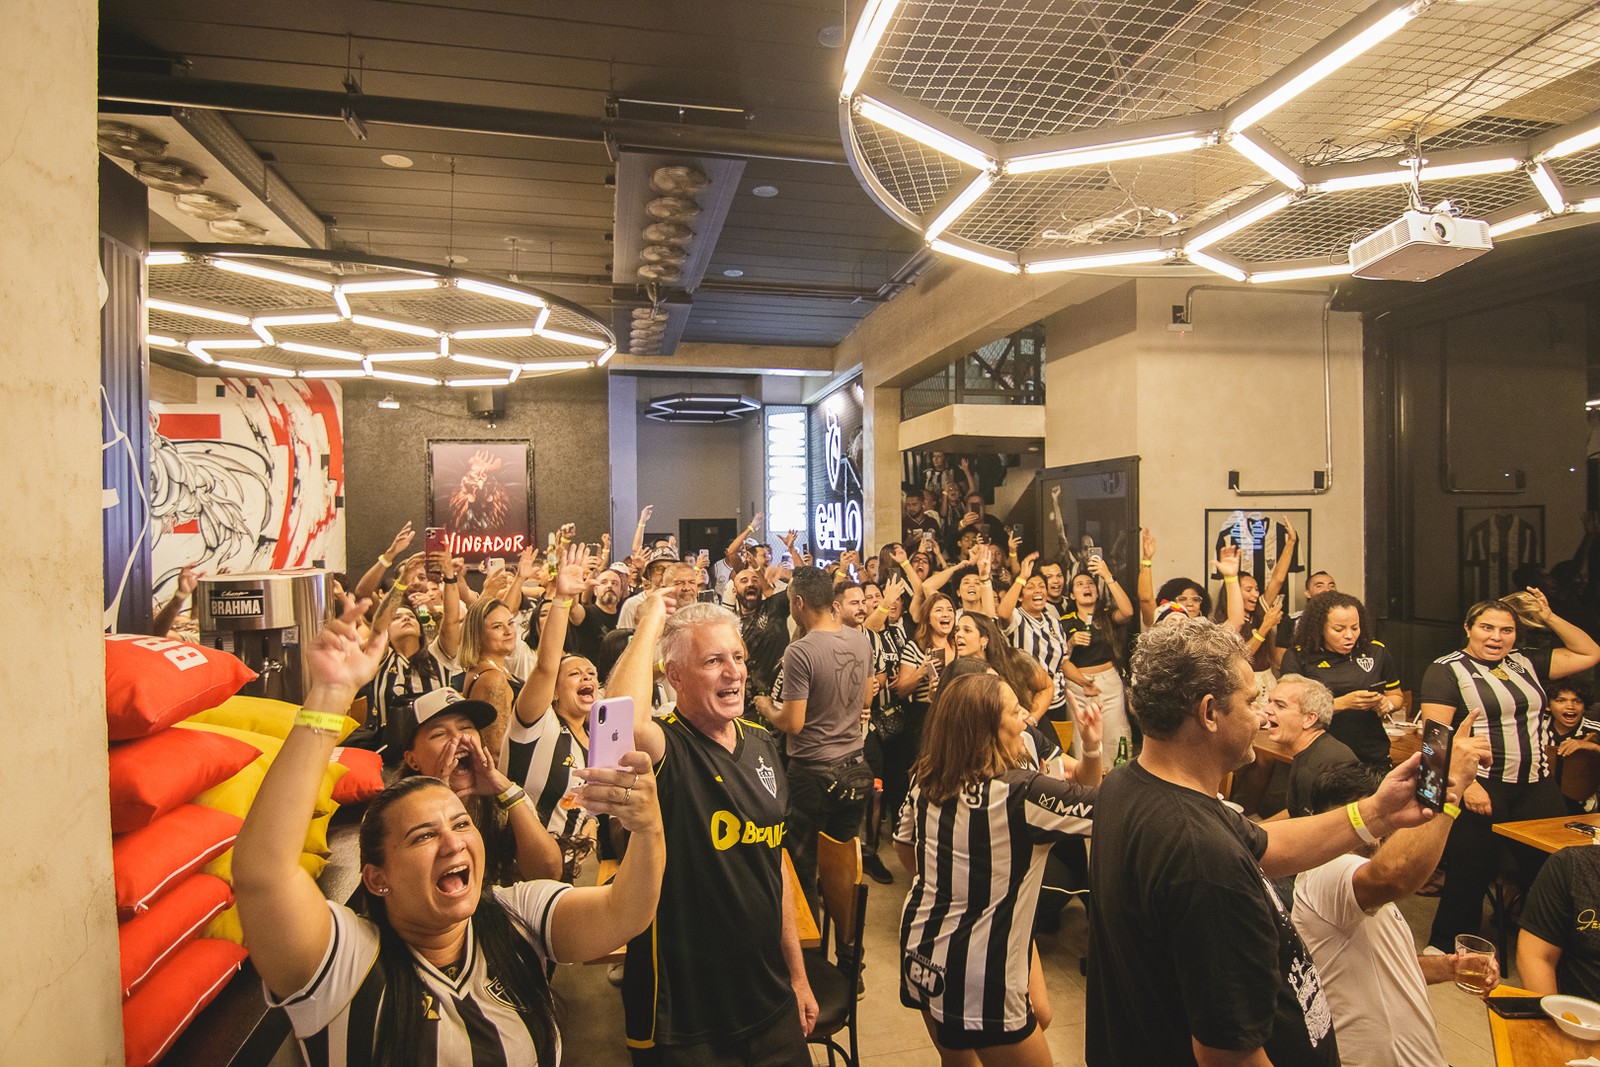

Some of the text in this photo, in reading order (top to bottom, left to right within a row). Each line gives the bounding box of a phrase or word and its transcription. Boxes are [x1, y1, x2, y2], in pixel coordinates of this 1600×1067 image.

[815, 500, 862, 551] GALO
[211, 599, 261, 615] BRAHMA
[910, 960, 937, 993] BH
